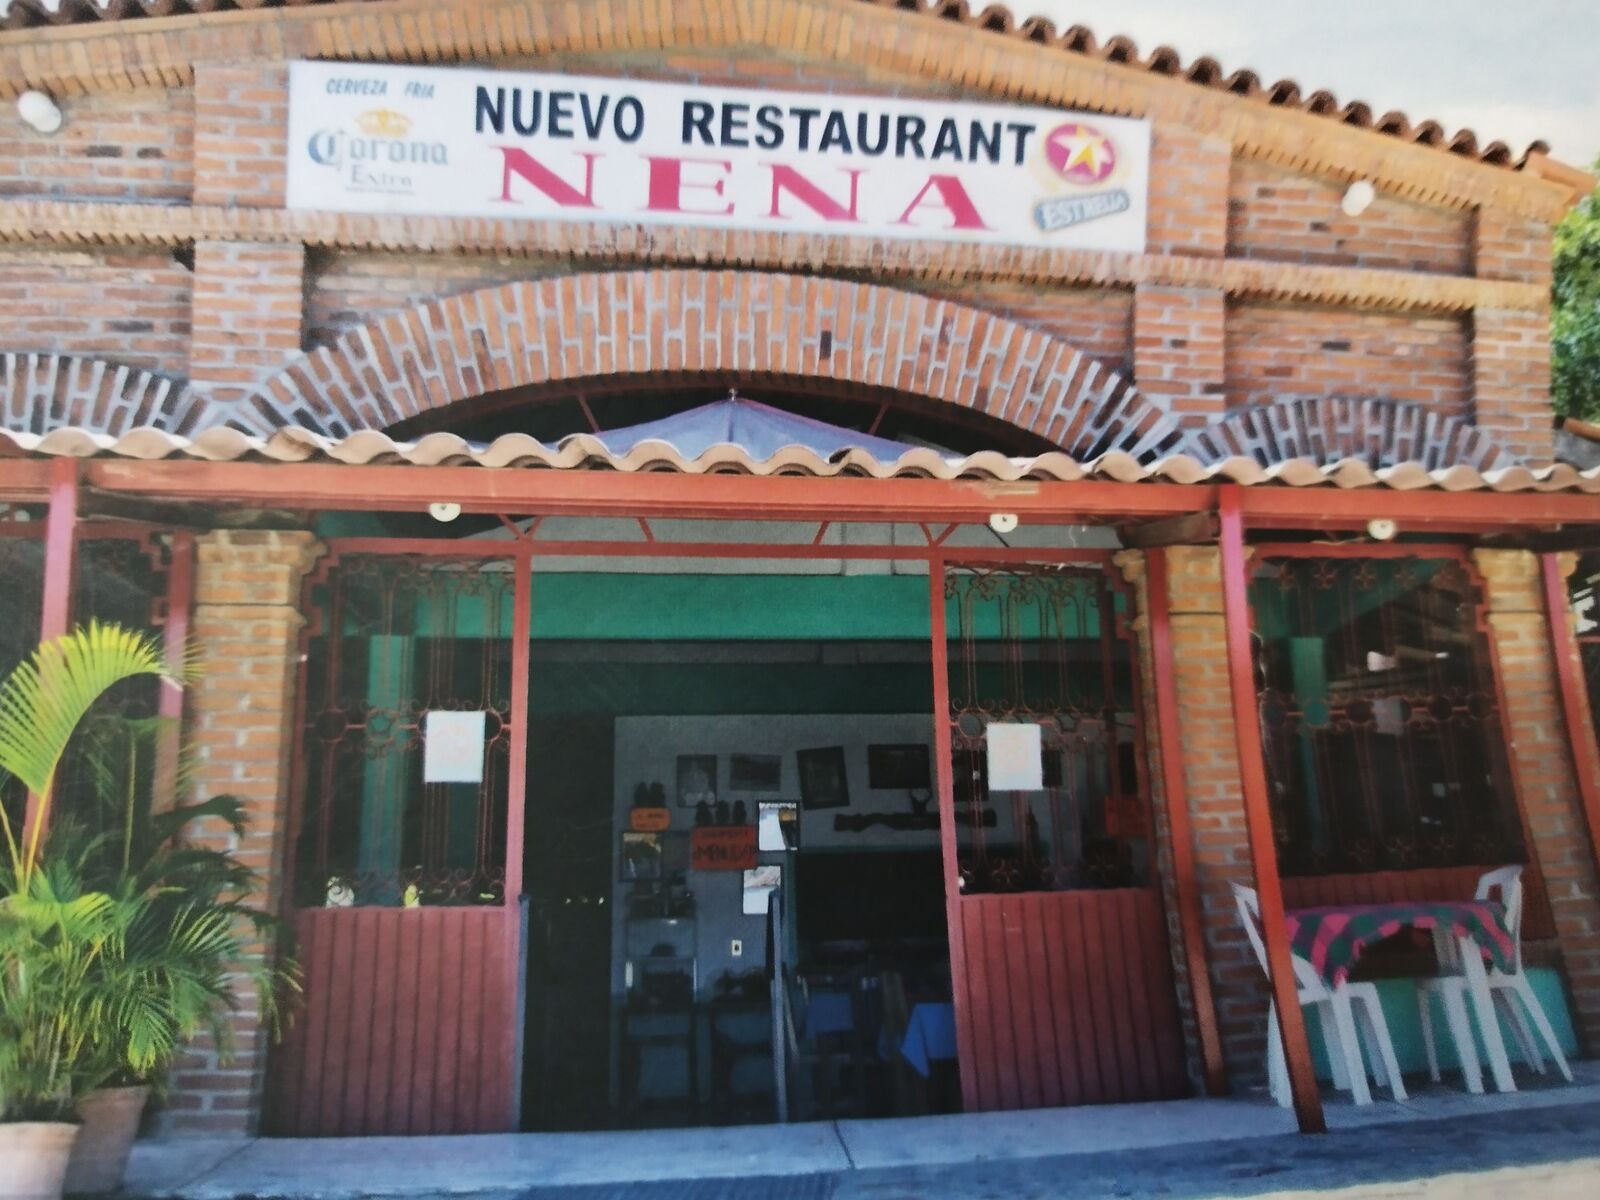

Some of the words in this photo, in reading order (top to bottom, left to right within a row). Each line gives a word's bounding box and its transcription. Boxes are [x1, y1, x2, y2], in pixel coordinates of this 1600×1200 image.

[325, 77, 388, 96] CERVEZA
[404, 80, 436, 99] FRIA
[475, 85, 645, 143] NUEVO
[682, 100, 1036, 165] RESTAURANT
[307, 128, 449, 171] Corona
[351, 163, 412, 187] Extra
[488, 144, 993, 231] NENA
